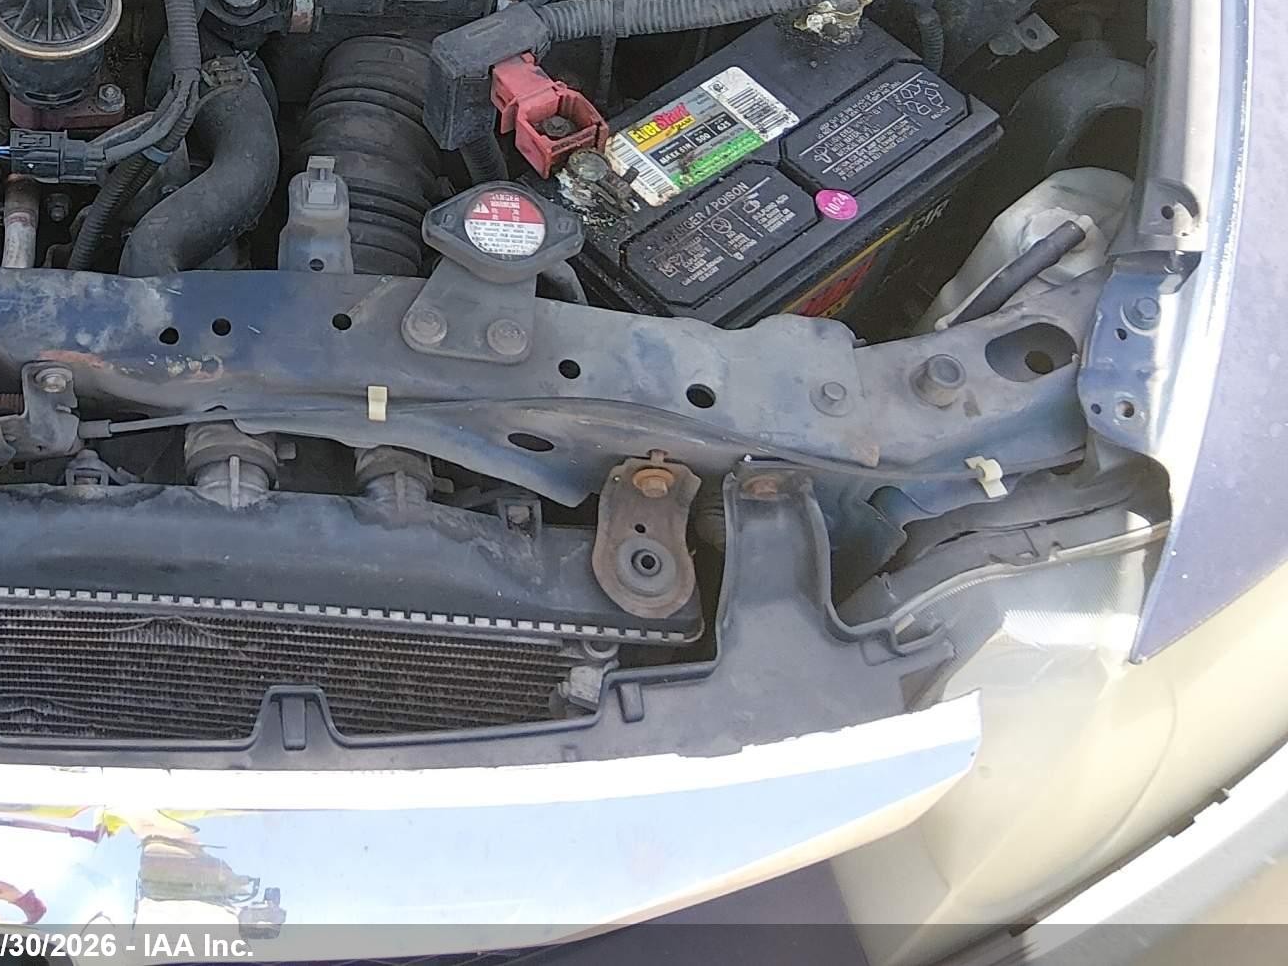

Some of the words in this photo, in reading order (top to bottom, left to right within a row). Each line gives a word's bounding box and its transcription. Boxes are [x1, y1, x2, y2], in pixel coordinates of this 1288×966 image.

[627, 102, 691, 144] EverStart
[716, 121, 732, 133] 625
[694, 132, 711, 145] 500
[713, 181, 750, 211] POISON
[824, 192, 850, 216] 10/24
